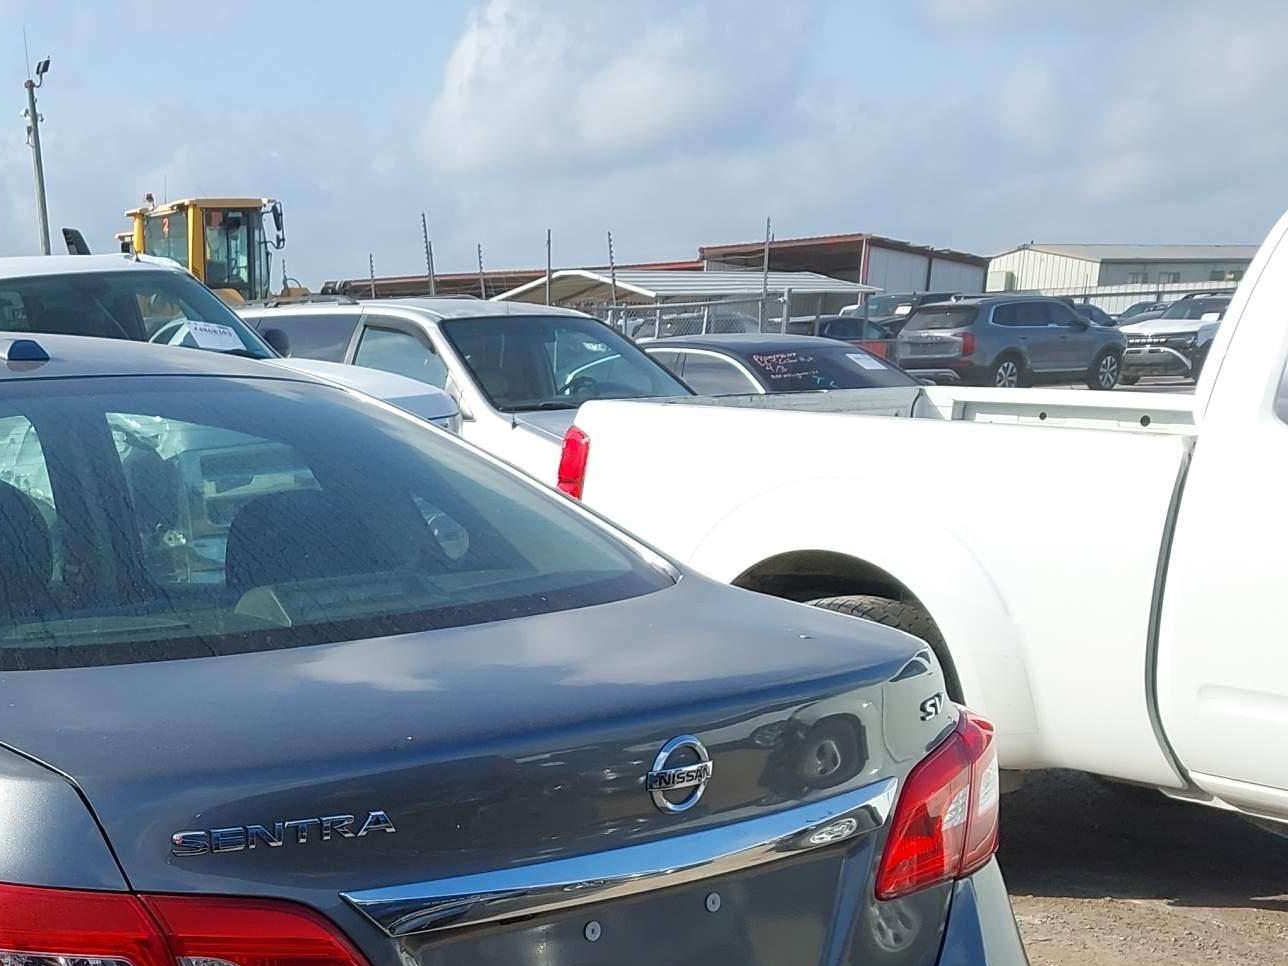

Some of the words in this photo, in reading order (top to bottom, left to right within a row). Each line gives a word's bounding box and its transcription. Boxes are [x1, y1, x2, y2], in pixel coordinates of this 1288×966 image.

[919, 692, 945, 722] SV
[657, 764, 711, 787] NISSAN
[170, 808, 397, 858] SENTRA
